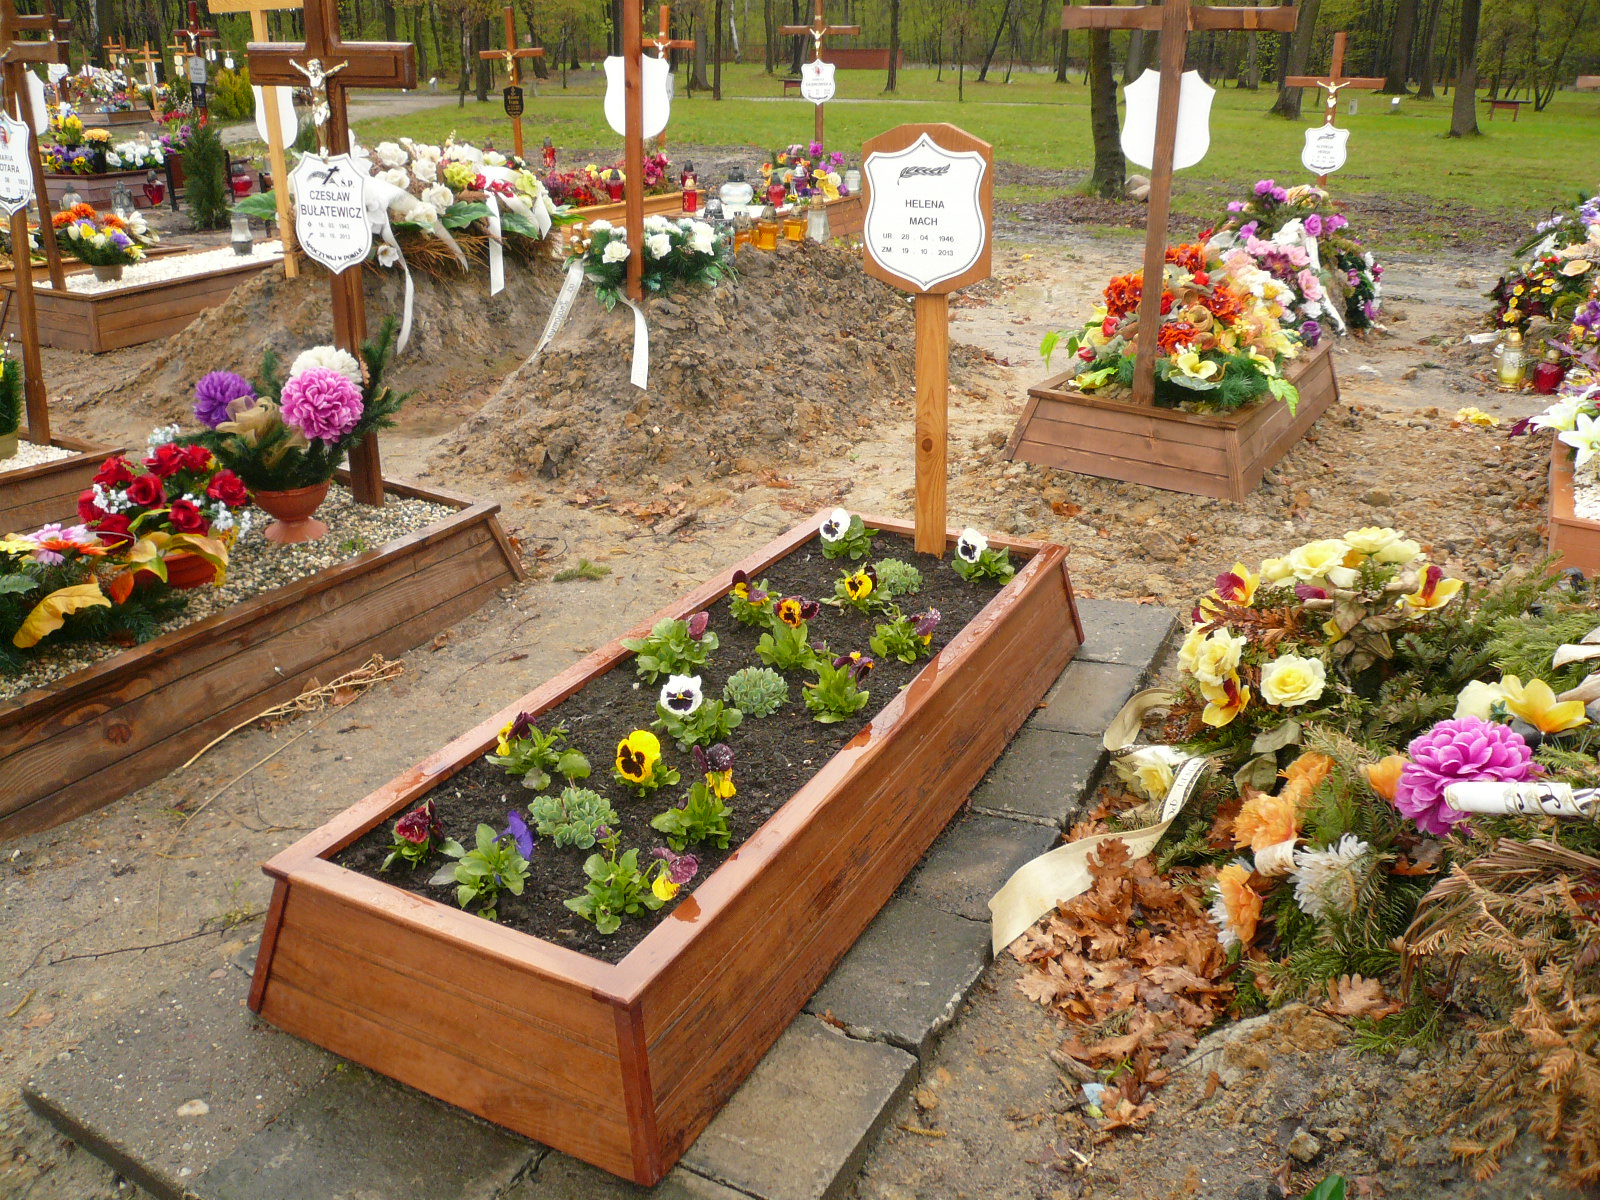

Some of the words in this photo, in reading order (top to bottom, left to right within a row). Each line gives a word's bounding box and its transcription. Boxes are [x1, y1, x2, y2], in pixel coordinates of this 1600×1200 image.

[0, 154, 14, 162] ARIA
[309, 190, 351, 202] CZESŁAW
[905, 199, 945, 209] HELENA
[300, 204, 362, 219] BUŁATEWICZ
[909, 217, 938, 226] MACH
